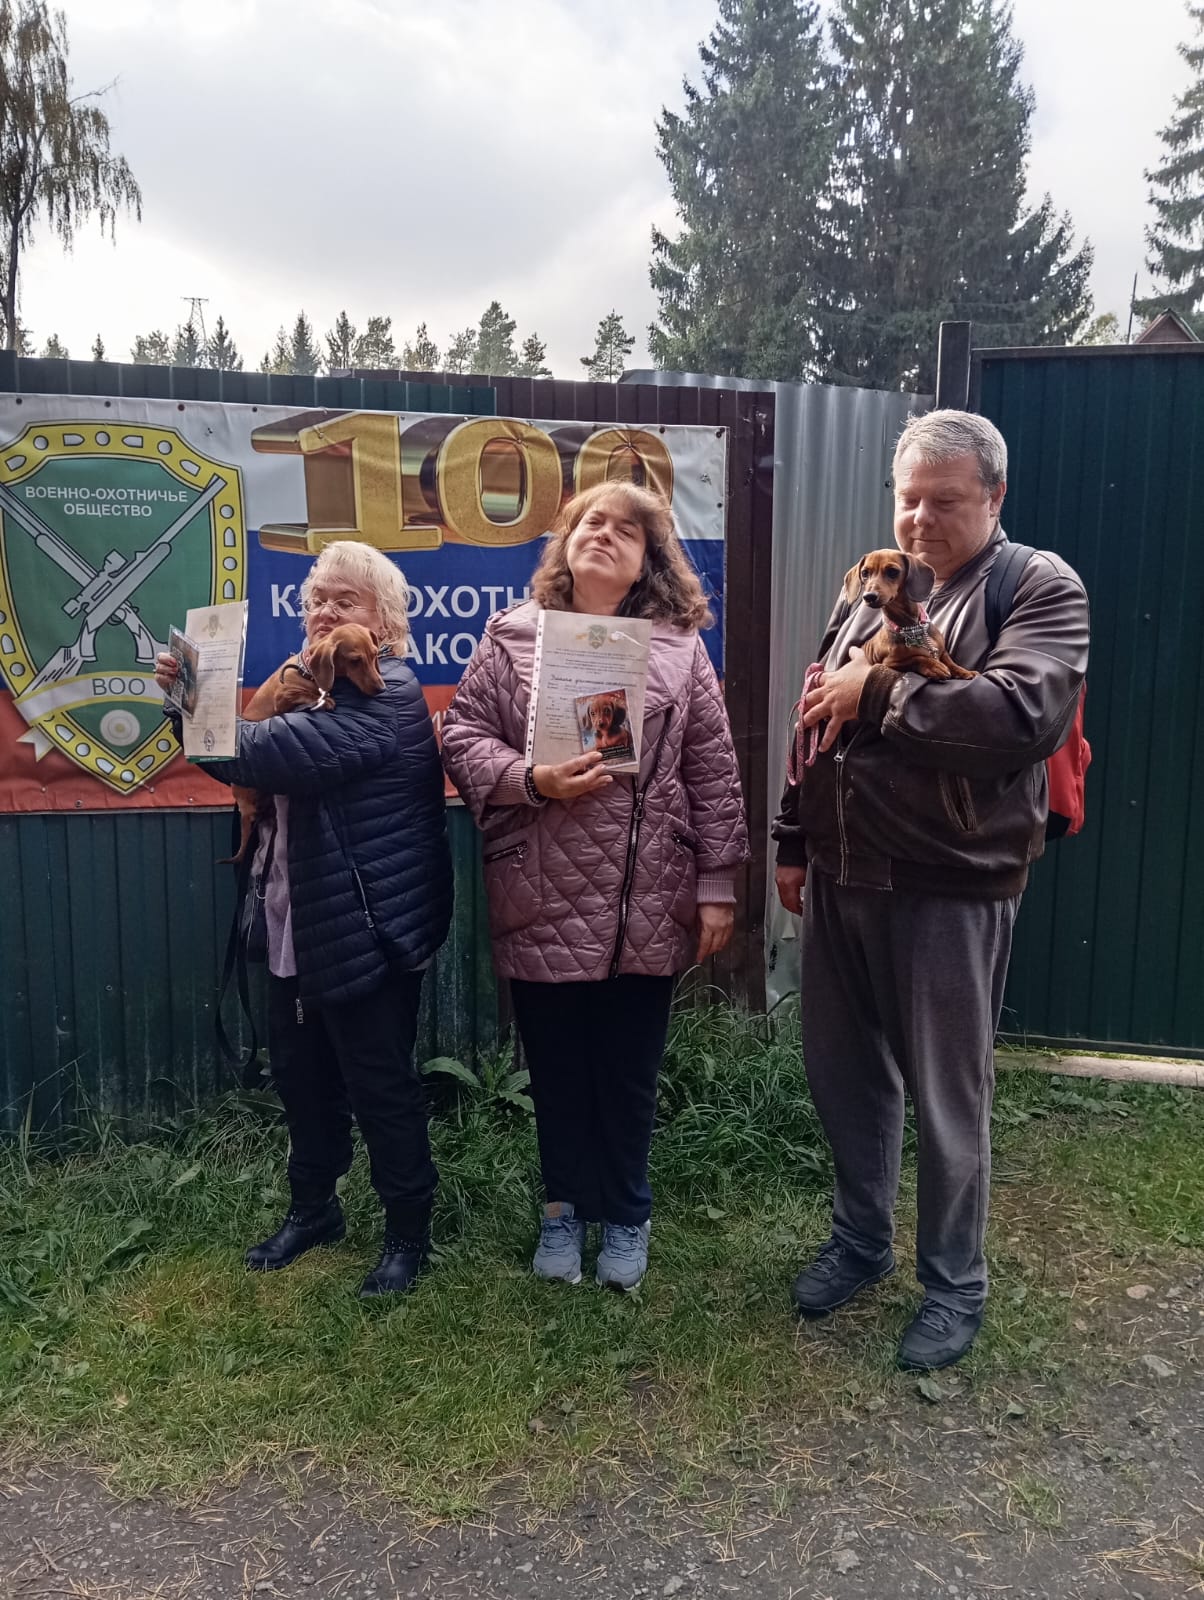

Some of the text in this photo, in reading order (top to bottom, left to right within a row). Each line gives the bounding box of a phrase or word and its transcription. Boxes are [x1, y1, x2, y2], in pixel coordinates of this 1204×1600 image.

[24, 486, 189, 504] ВОЕННО-ОХОТНИЧЬЕ
[63, 503, 153, 518] ОБЩЕСТВО
[92, 677, 146, 696] ВОО
